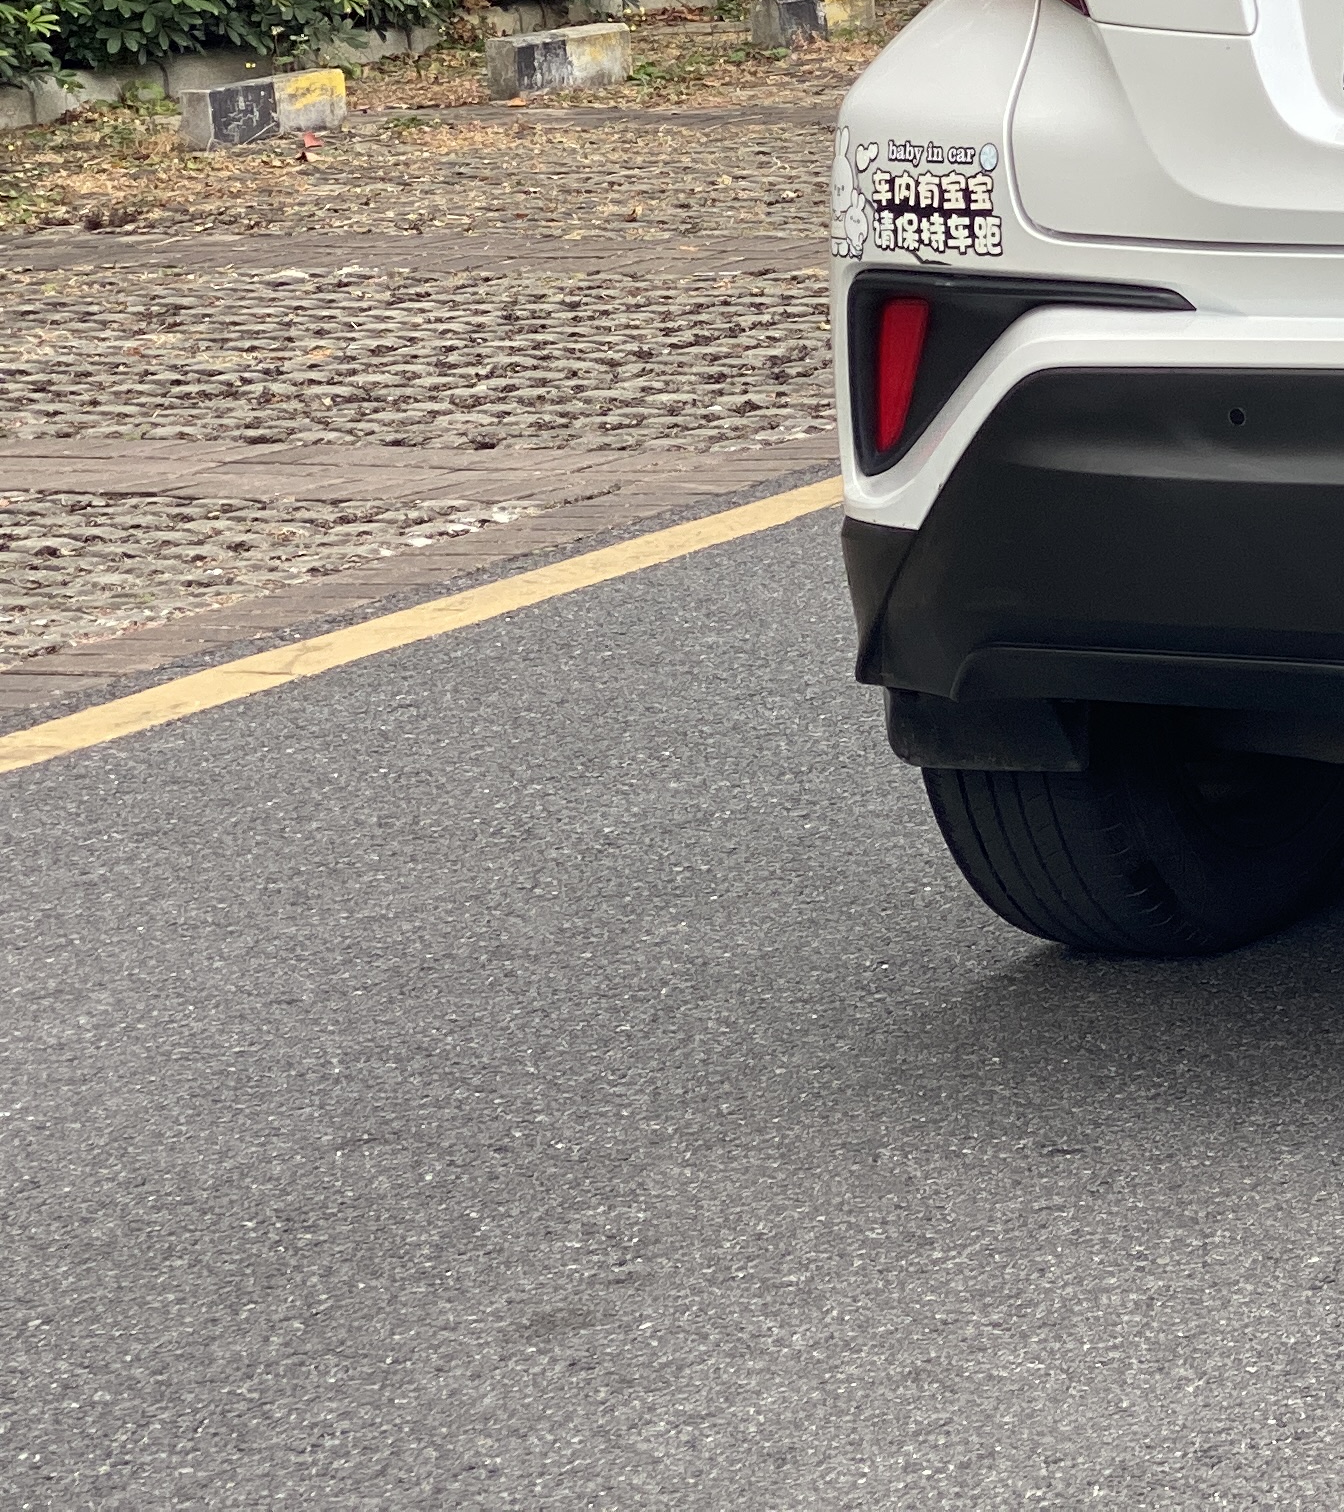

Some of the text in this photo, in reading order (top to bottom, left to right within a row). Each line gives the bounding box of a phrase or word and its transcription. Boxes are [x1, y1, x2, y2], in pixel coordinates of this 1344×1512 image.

[887, 139, 977, 167] baby in car
[872, 168, 994, 211] 车内有宝宝
[873, 209, 1003, 257] 请保持车距
